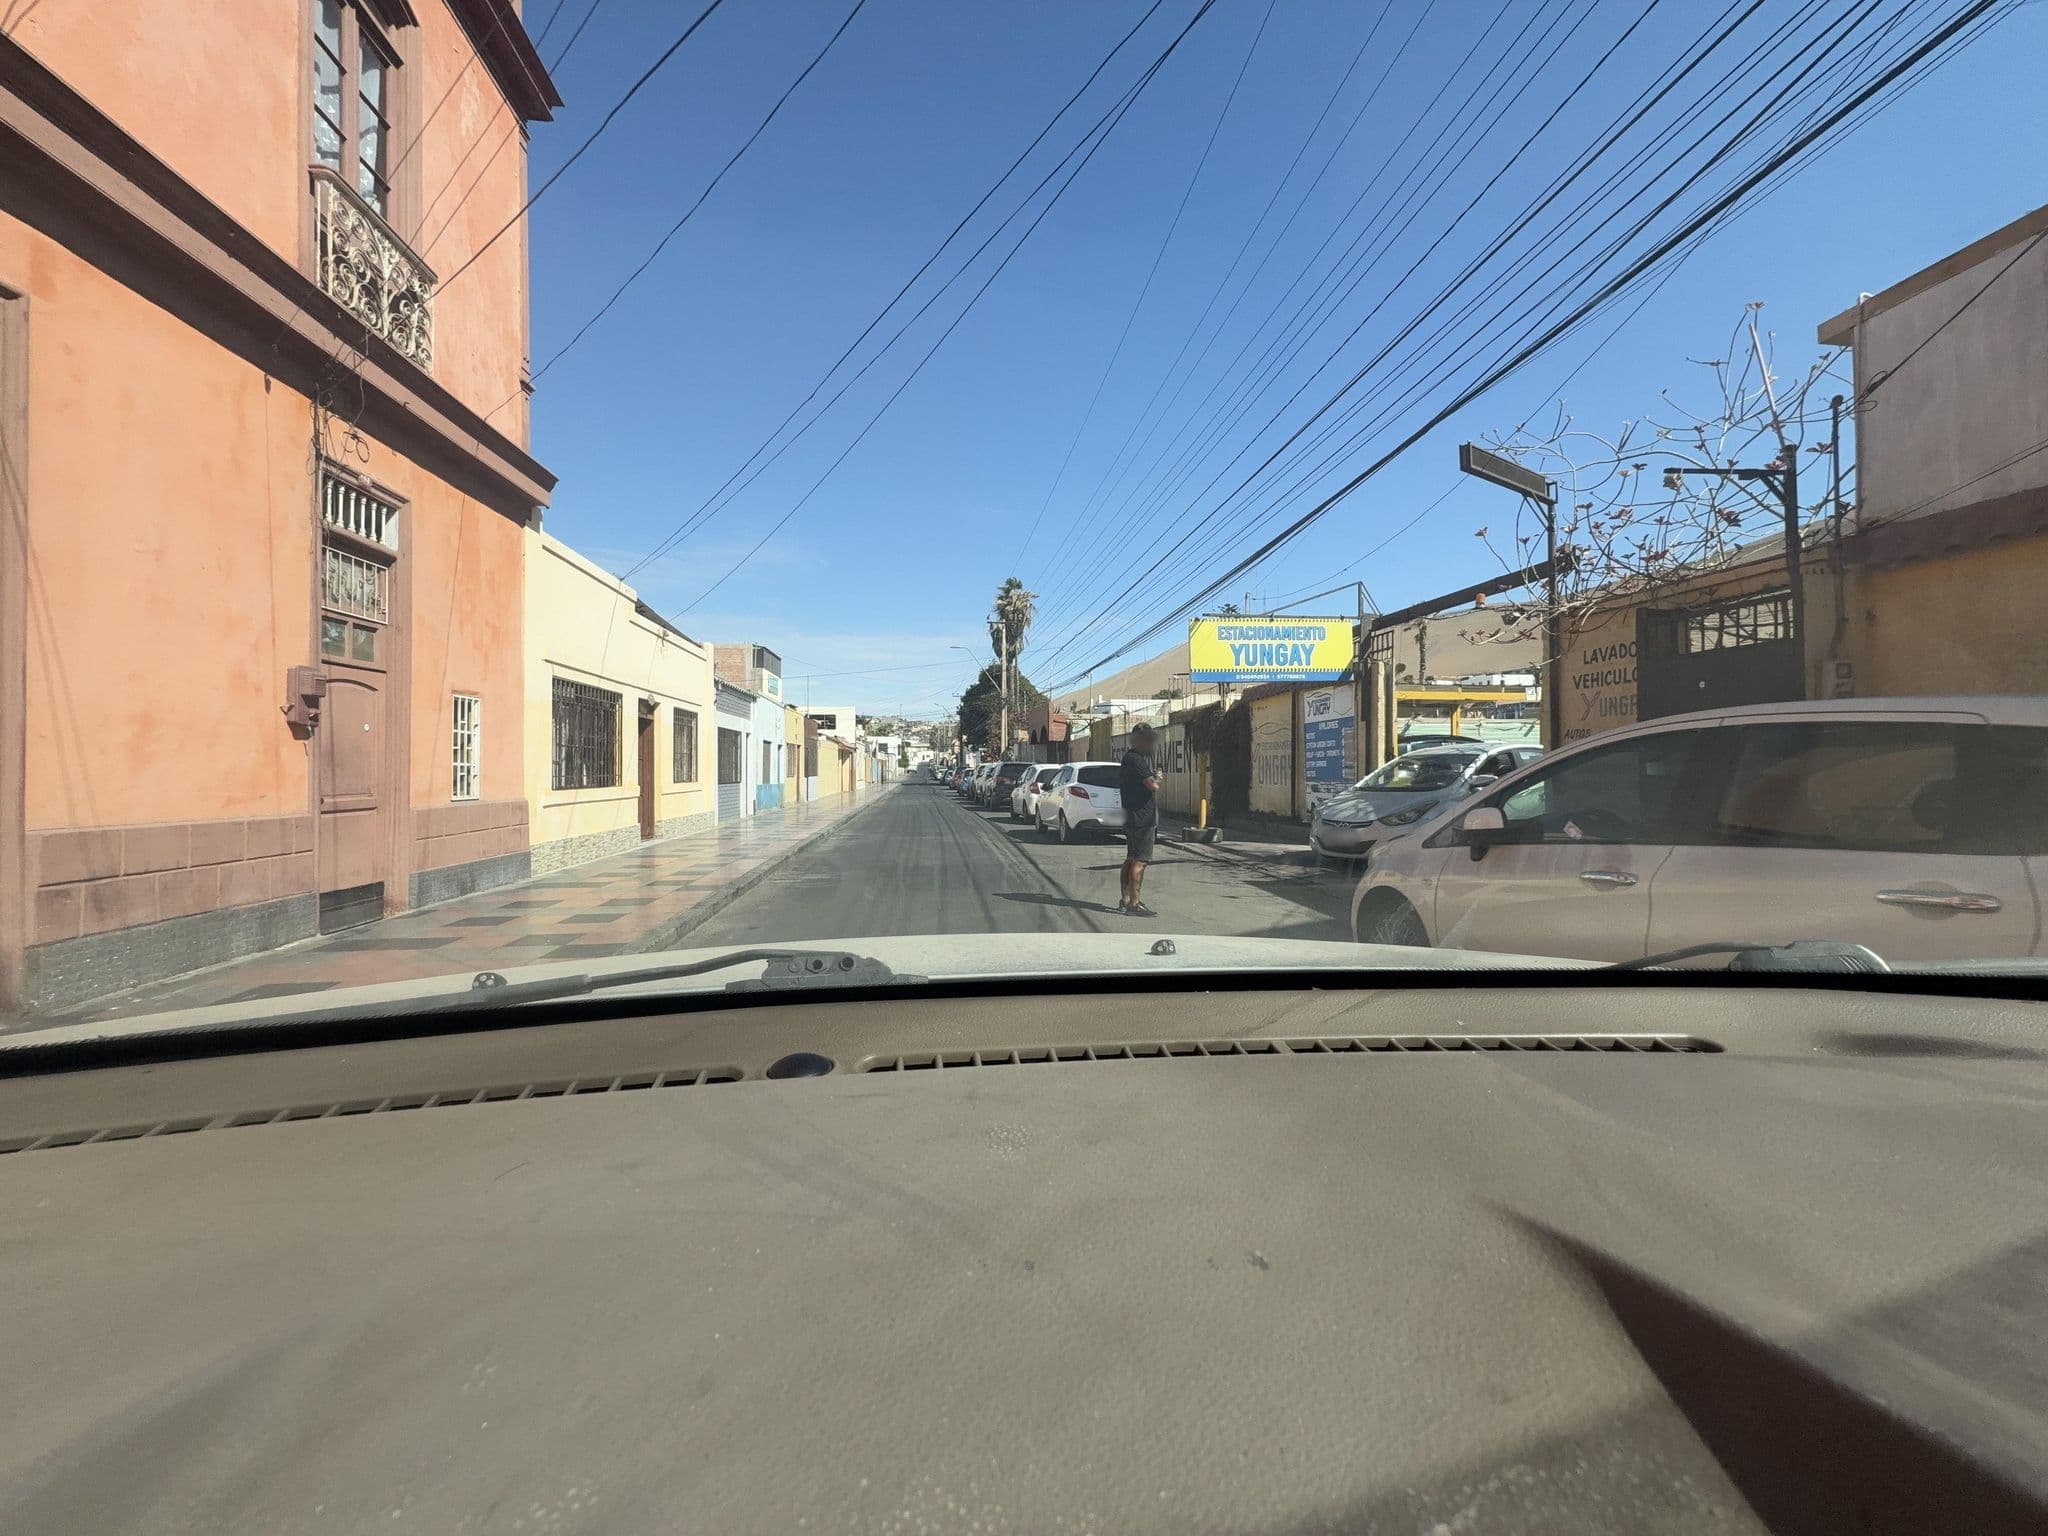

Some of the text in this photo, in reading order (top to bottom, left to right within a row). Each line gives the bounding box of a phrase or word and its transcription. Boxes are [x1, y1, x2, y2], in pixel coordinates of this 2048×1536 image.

[1217, 625, 1326, 641] ESTACIONAMIENTO
[1229, 643, 1316, 667] YUNGAY
[1583, 641, 1638, 665] LAVADO
